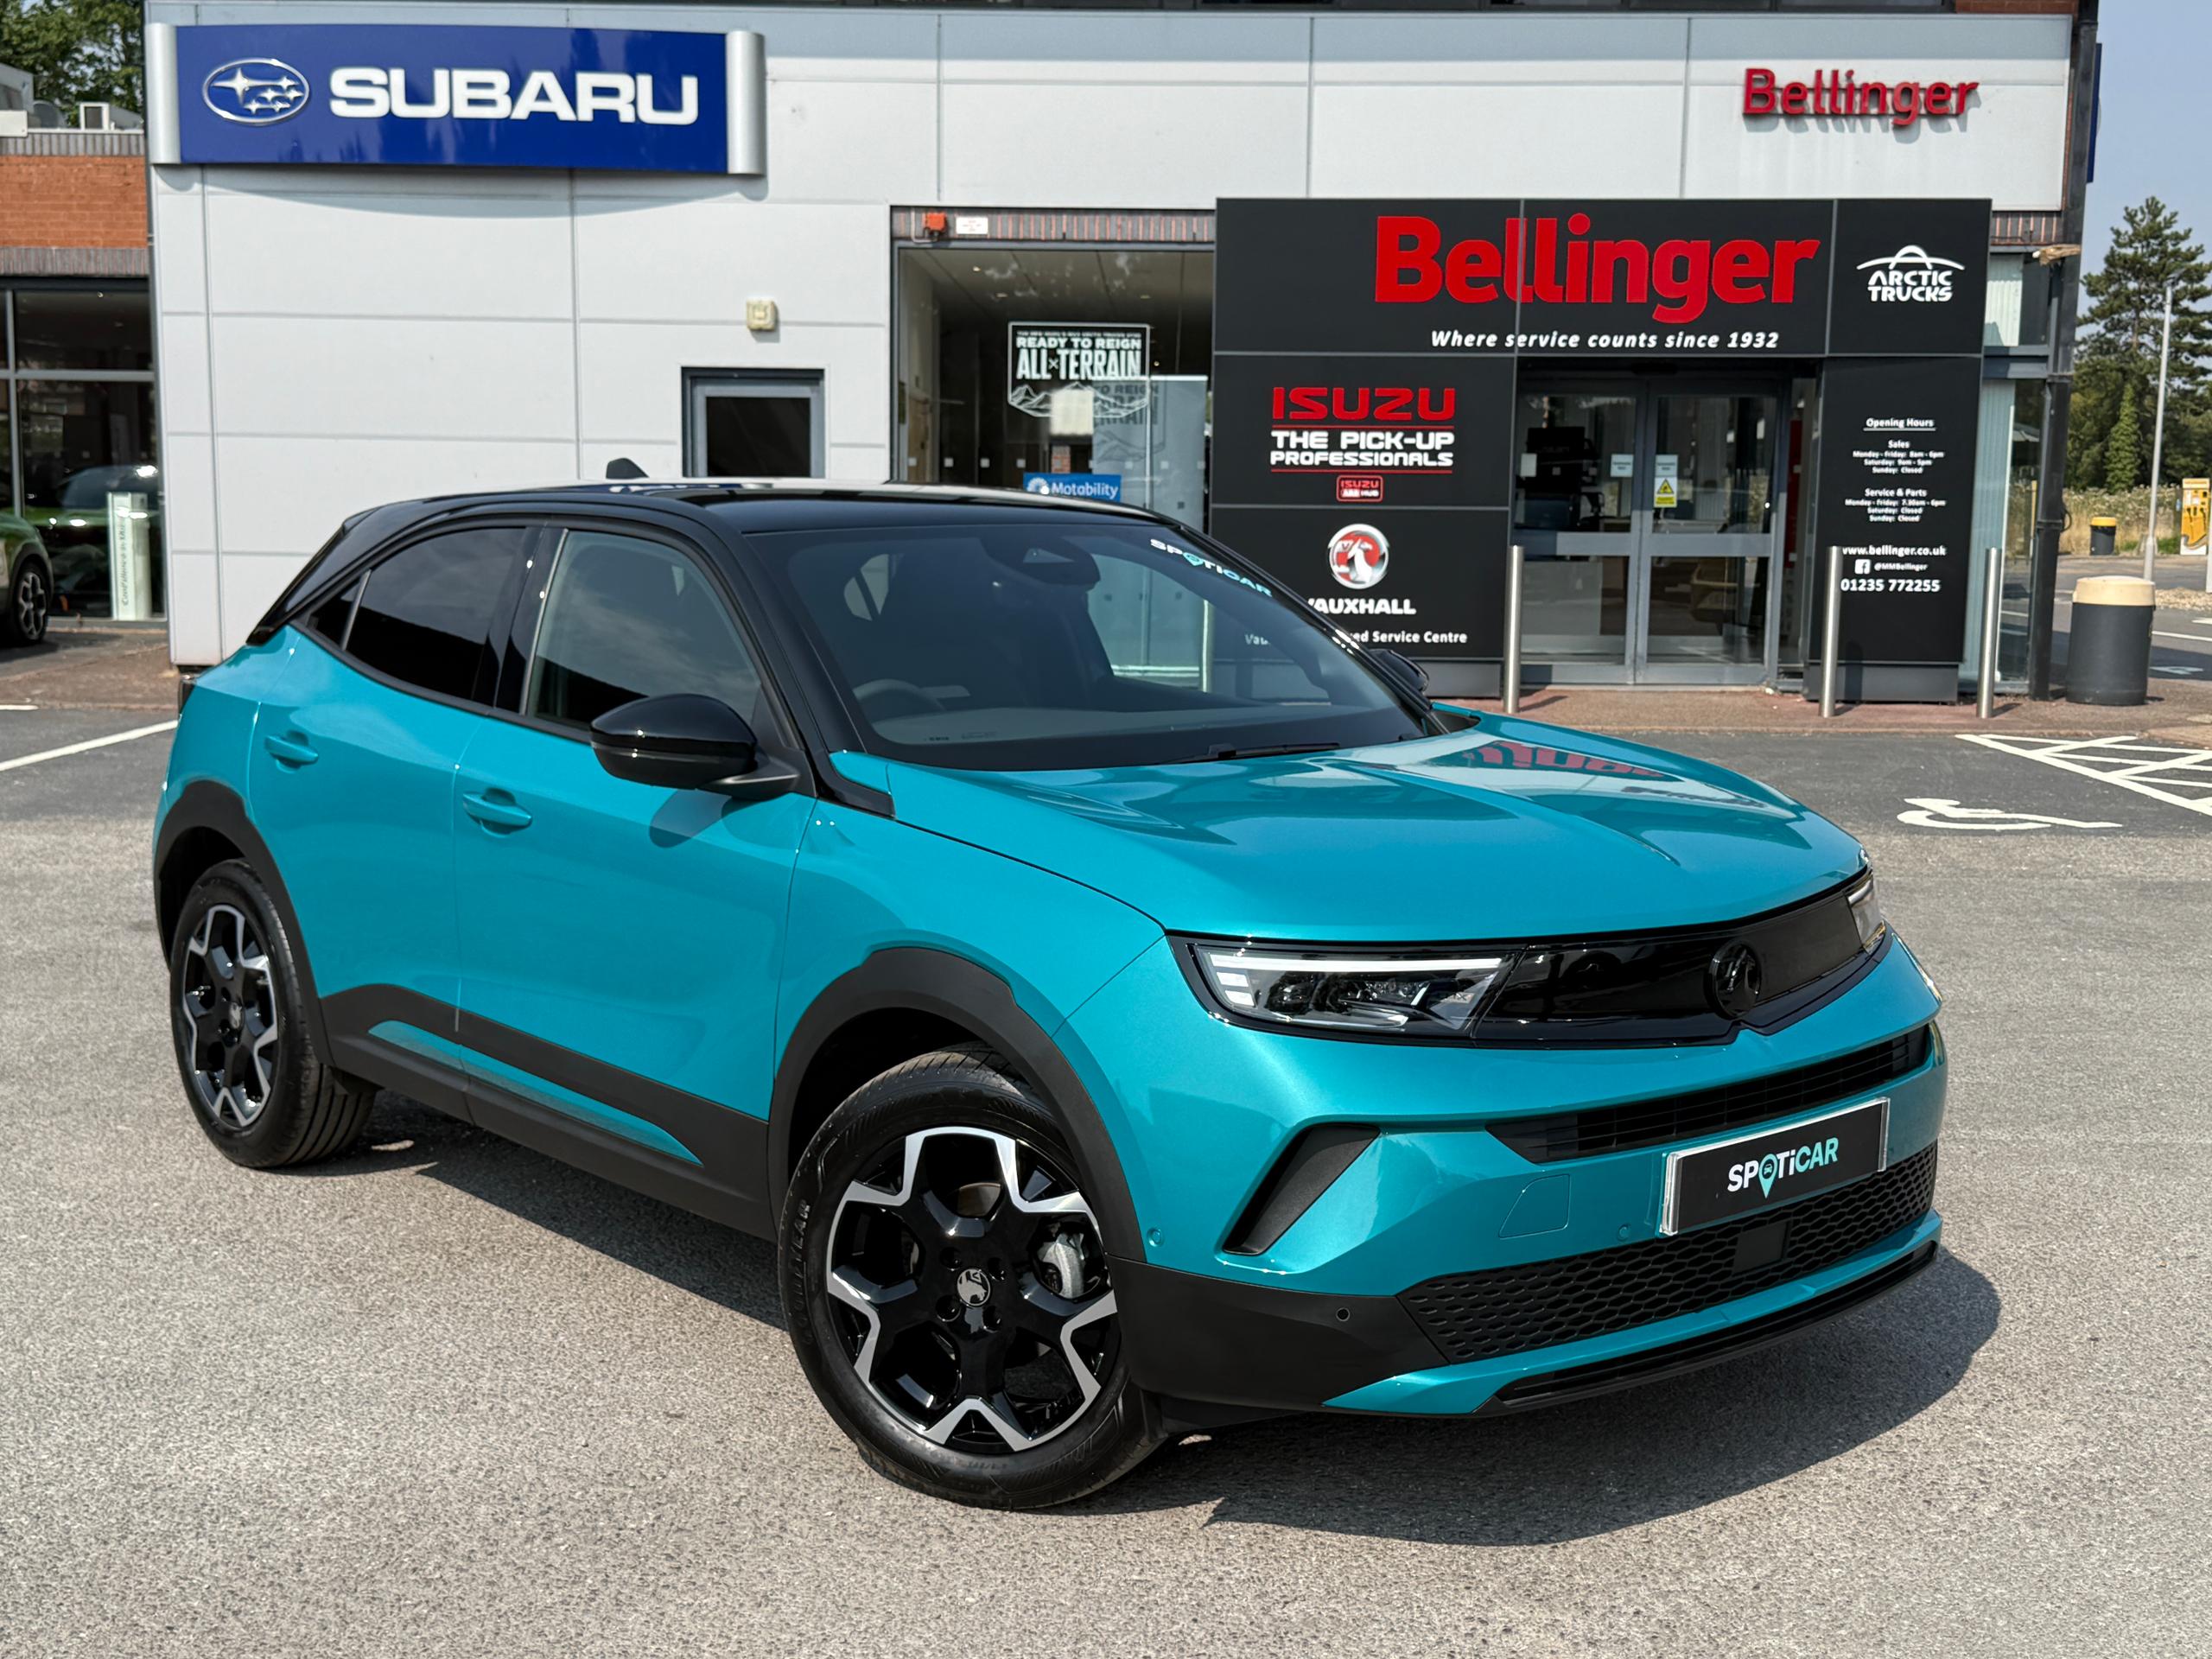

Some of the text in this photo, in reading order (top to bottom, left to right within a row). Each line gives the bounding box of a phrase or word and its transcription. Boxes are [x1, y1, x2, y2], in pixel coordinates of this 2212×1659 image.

[329, 67, 699, 126] SUBARU
[1743, 68, 1980, 125] Bellinger
[1375, 213, 1821, 323] Bellinger
[1868, 270, 1953, 286] ARCTIC
[1867, 286, 1953, 302] TRUCKS
[1016, 337, 1141, 350] READY TO REIGN
[1431, 330, 1779, 348] Where service counts since 1932
[1016, 349, 1141, 380] ALL TERRAIN
[1272, 387, 1456, 421] ISUZU
[1866, 417, 1935, 429] Opening Hours
[1270, 430, 1455, 450] THE PICK-UP
[1888, 439, 1910, 448] Sales
[1270, 450, 1453, 467] PROFESSIONALS
[1853, 450, 1879, 459] Monday
[1052, 482, 1119, 499] Motability
[1865, 488, 1928, 497] Service & Parts
[1842, 544, 1947, 557] www.bellinger.co.uk
[1150, 538, 1273, 597] SPOTICAR
[1840, 578, 1941, 592] 01235 772255
[1372, 630, 1421, 643] Service
[1423, 631, 1468, 643] Centre
